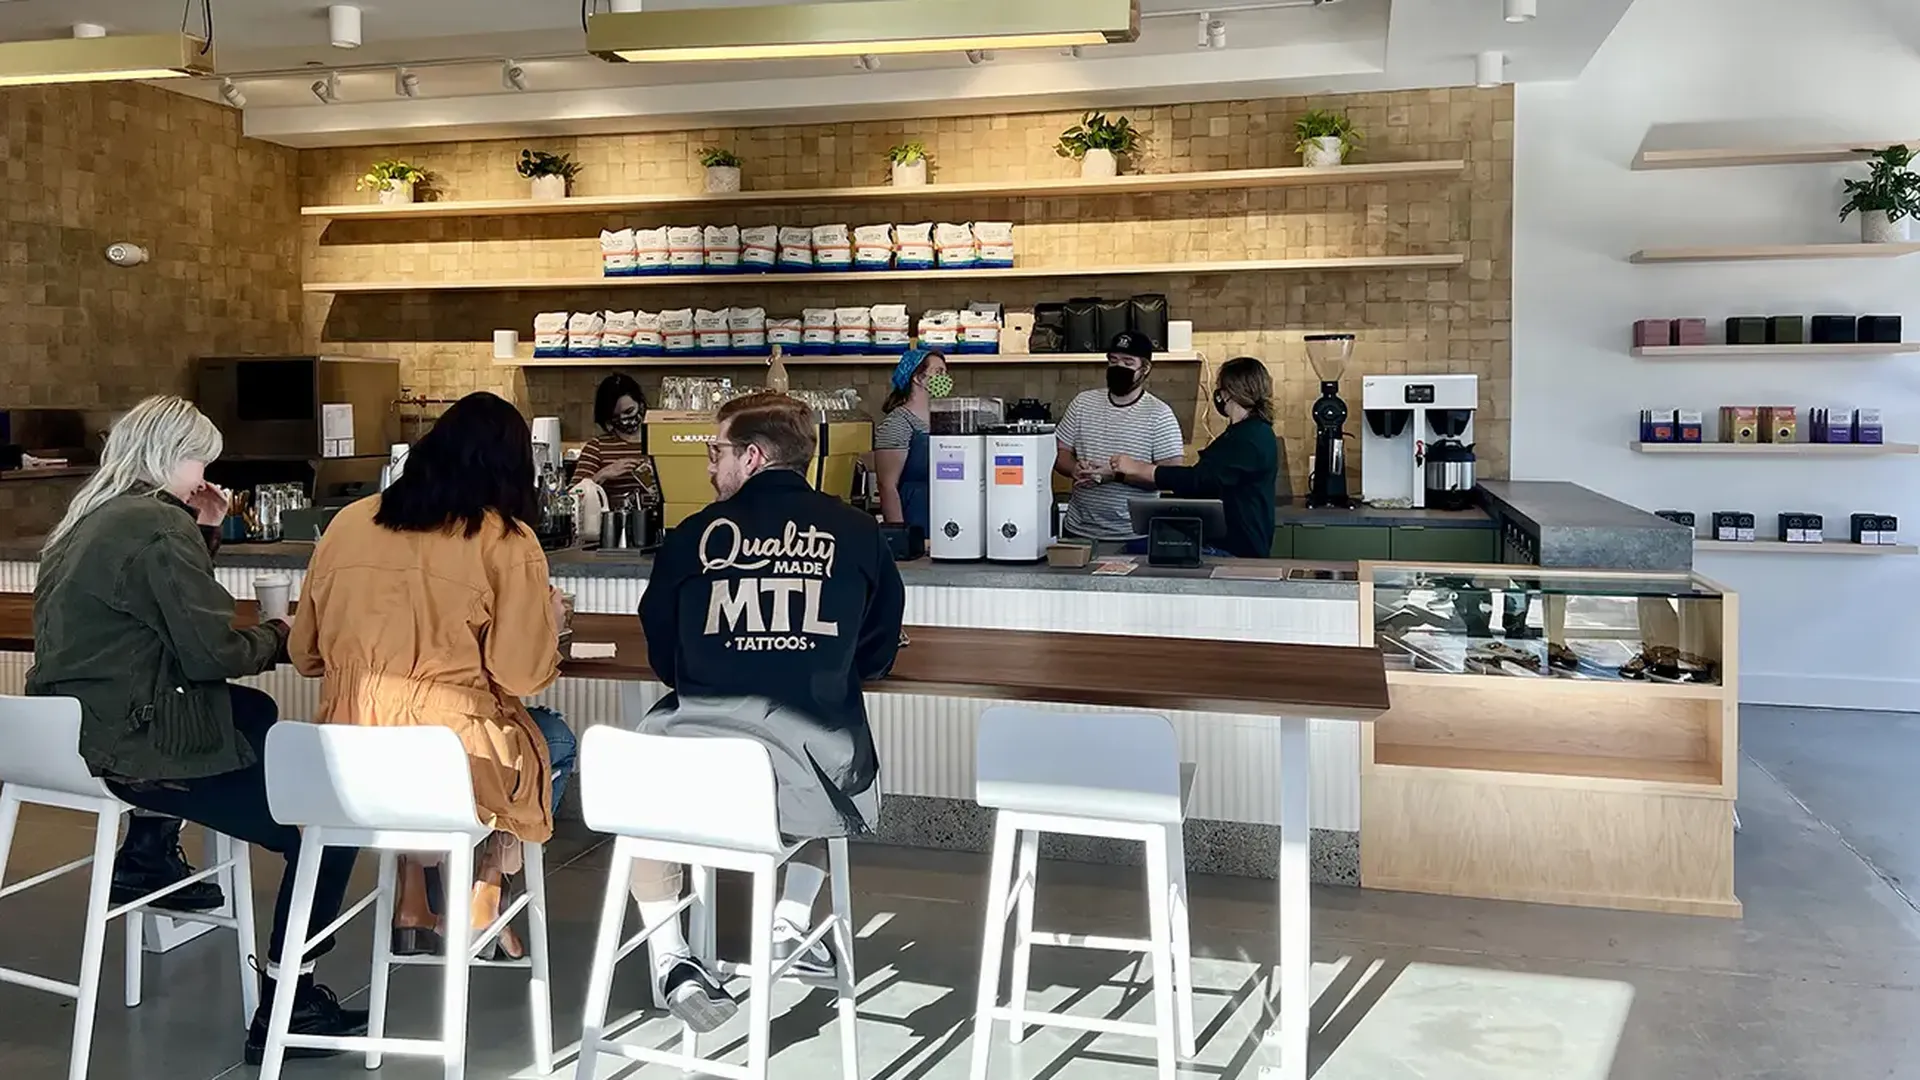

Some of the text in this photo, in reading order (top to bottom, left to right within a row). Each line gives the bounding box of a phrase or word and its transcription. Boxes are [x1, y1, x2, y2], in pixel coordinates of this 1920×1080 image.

[699, 517, 836, 578] Quality
[773, 561, 823, 576] MADE
[703, 578, 839, 637] MTL
[734, 636, 808, 651] TATTOOS
